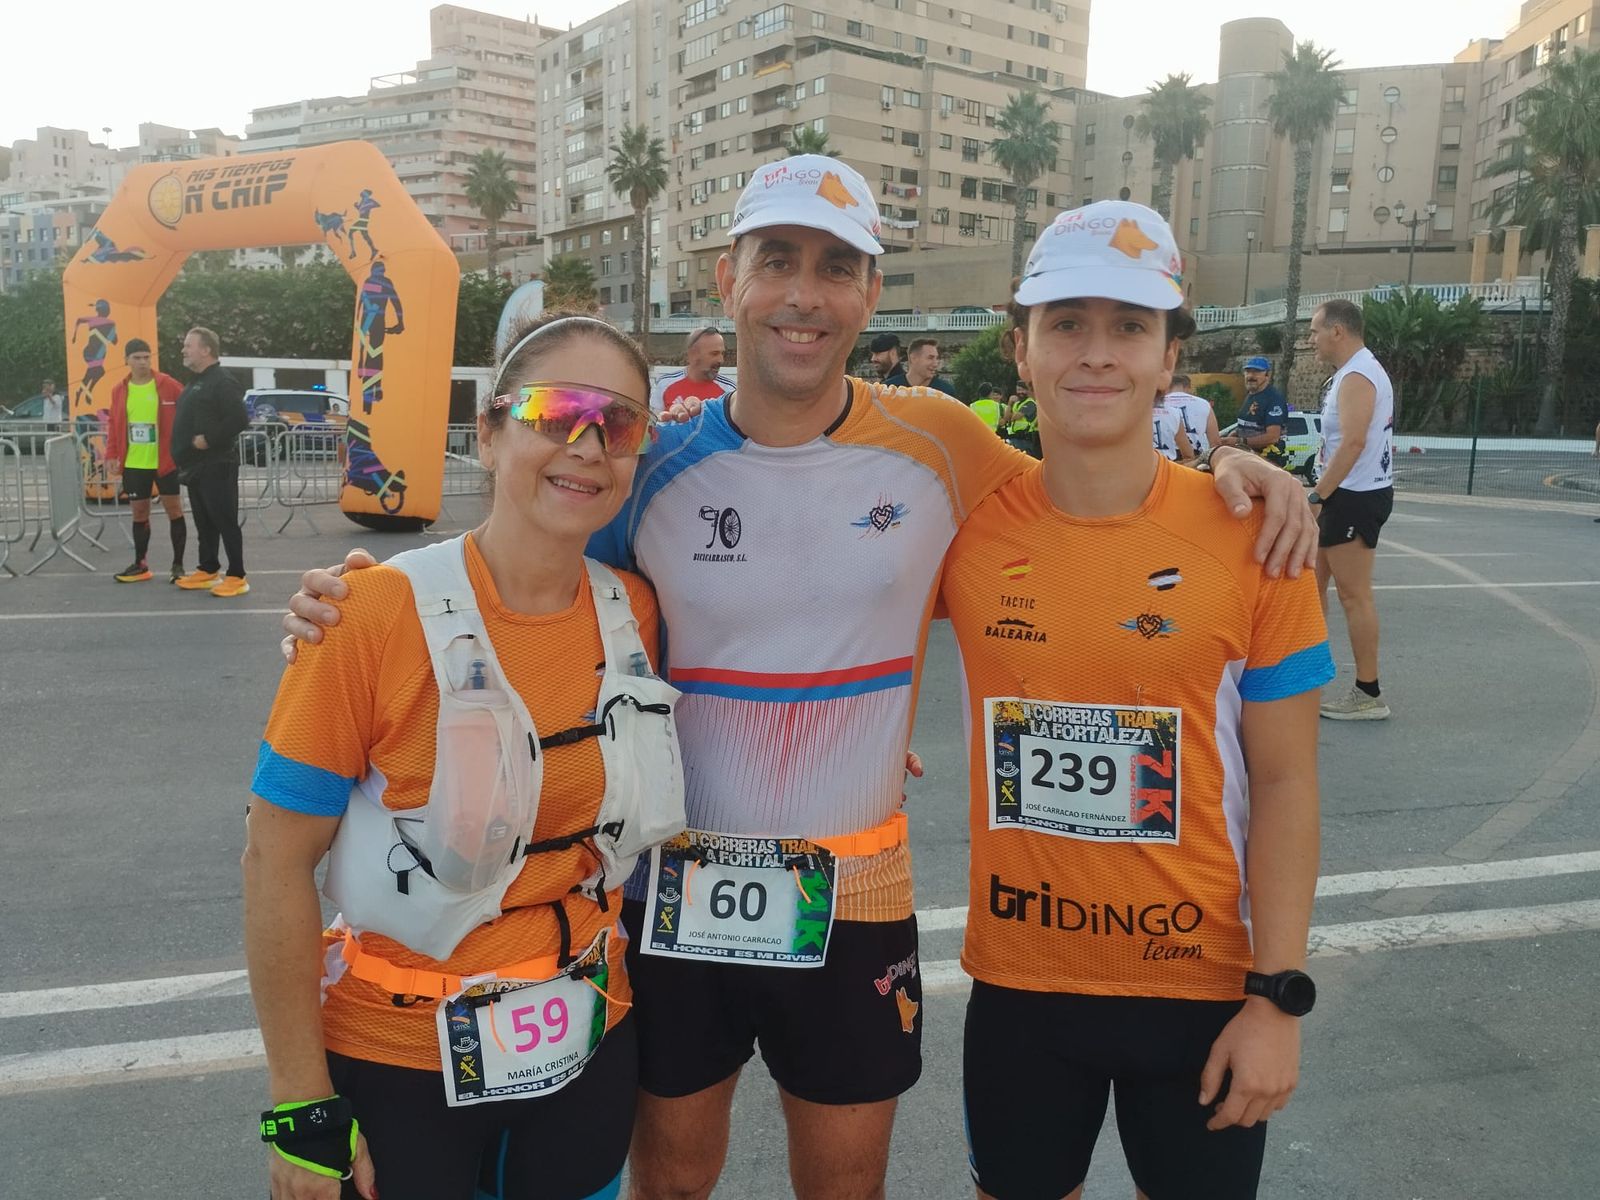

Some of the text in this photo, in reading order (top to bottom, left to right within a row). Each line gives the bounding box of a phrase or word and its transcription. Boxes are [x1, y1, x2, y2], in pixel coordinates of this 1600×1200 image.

[187, 157, 296, 183] MIS TIEMPOS
[212, 173, 288, 211] CHIP
[1000, 595, 1036, 609] TACTIC
[1034, 704, 1112, 727] CORRERAS
[1115, 710, 1156, 730] TRAIL
[1030, 720, 1155, 746] LA FORTALEZA
[1031, 748, 1117, 795] 239
[1025, 803, 1127, 823] JOSÉ CARRACAO FERNÁNDEZ
[1136, 788, 1172, 823] K
[997, 815, 1174, 838] EL HONOR ES MI DIVISA
[700, 833, 777, 854] CORRERAS
[710, 879, 768, 922] 60
[688, 931, 782, 945] JOSÉ ANTONIO CARRACAO
[1142, 938, 1204, 960] team
[651, 942, 822, 961] EL HONOR ES MI DIVISA
[511, 997, 569, 1053] 59
[507, 1065, 543, 1081] MARÍA
[545, 1051, 579, 1073] CRISTINA
[458, 1091, 479, 1100] EL
[483, 1081, 545, 1097] HONOR
